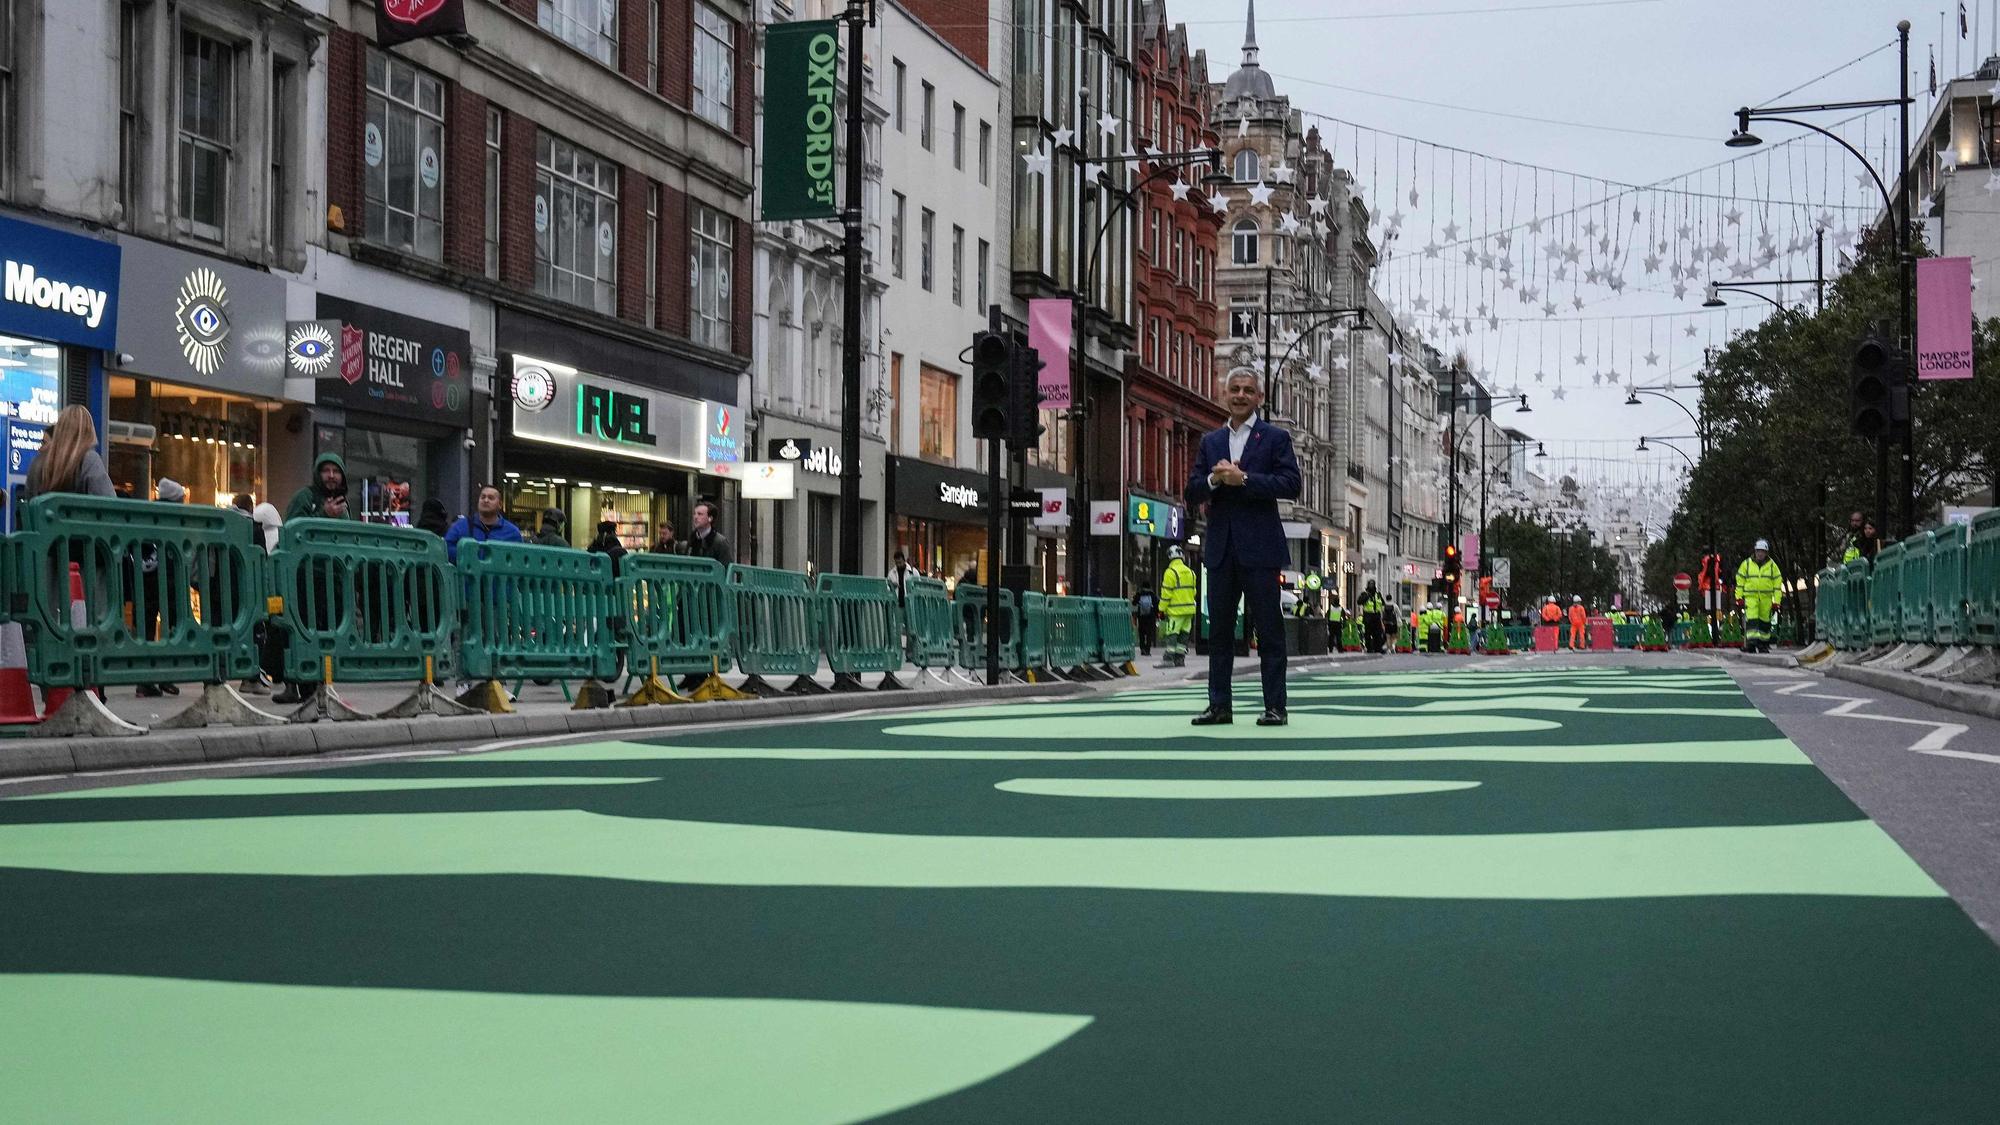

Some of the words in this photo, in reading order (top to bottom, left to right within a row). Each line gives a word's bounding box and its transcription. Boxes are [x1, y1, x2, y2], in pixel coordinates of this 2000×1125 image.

[806, 33, 836, 180] OXFORD
[5, 259, 107, 328] Money
[369, 331, 421, 366] REGENT
[1920, 351, 1960, 361] MAYOR
[369, 358, 404, 388] HALL
[1920, 360, 1970, 370] LONDON
[1038, 384, 1060, 393] AYOR
[580, 384, 656, 446] FUEL
[940, 482, 979, 509] Samsonite
